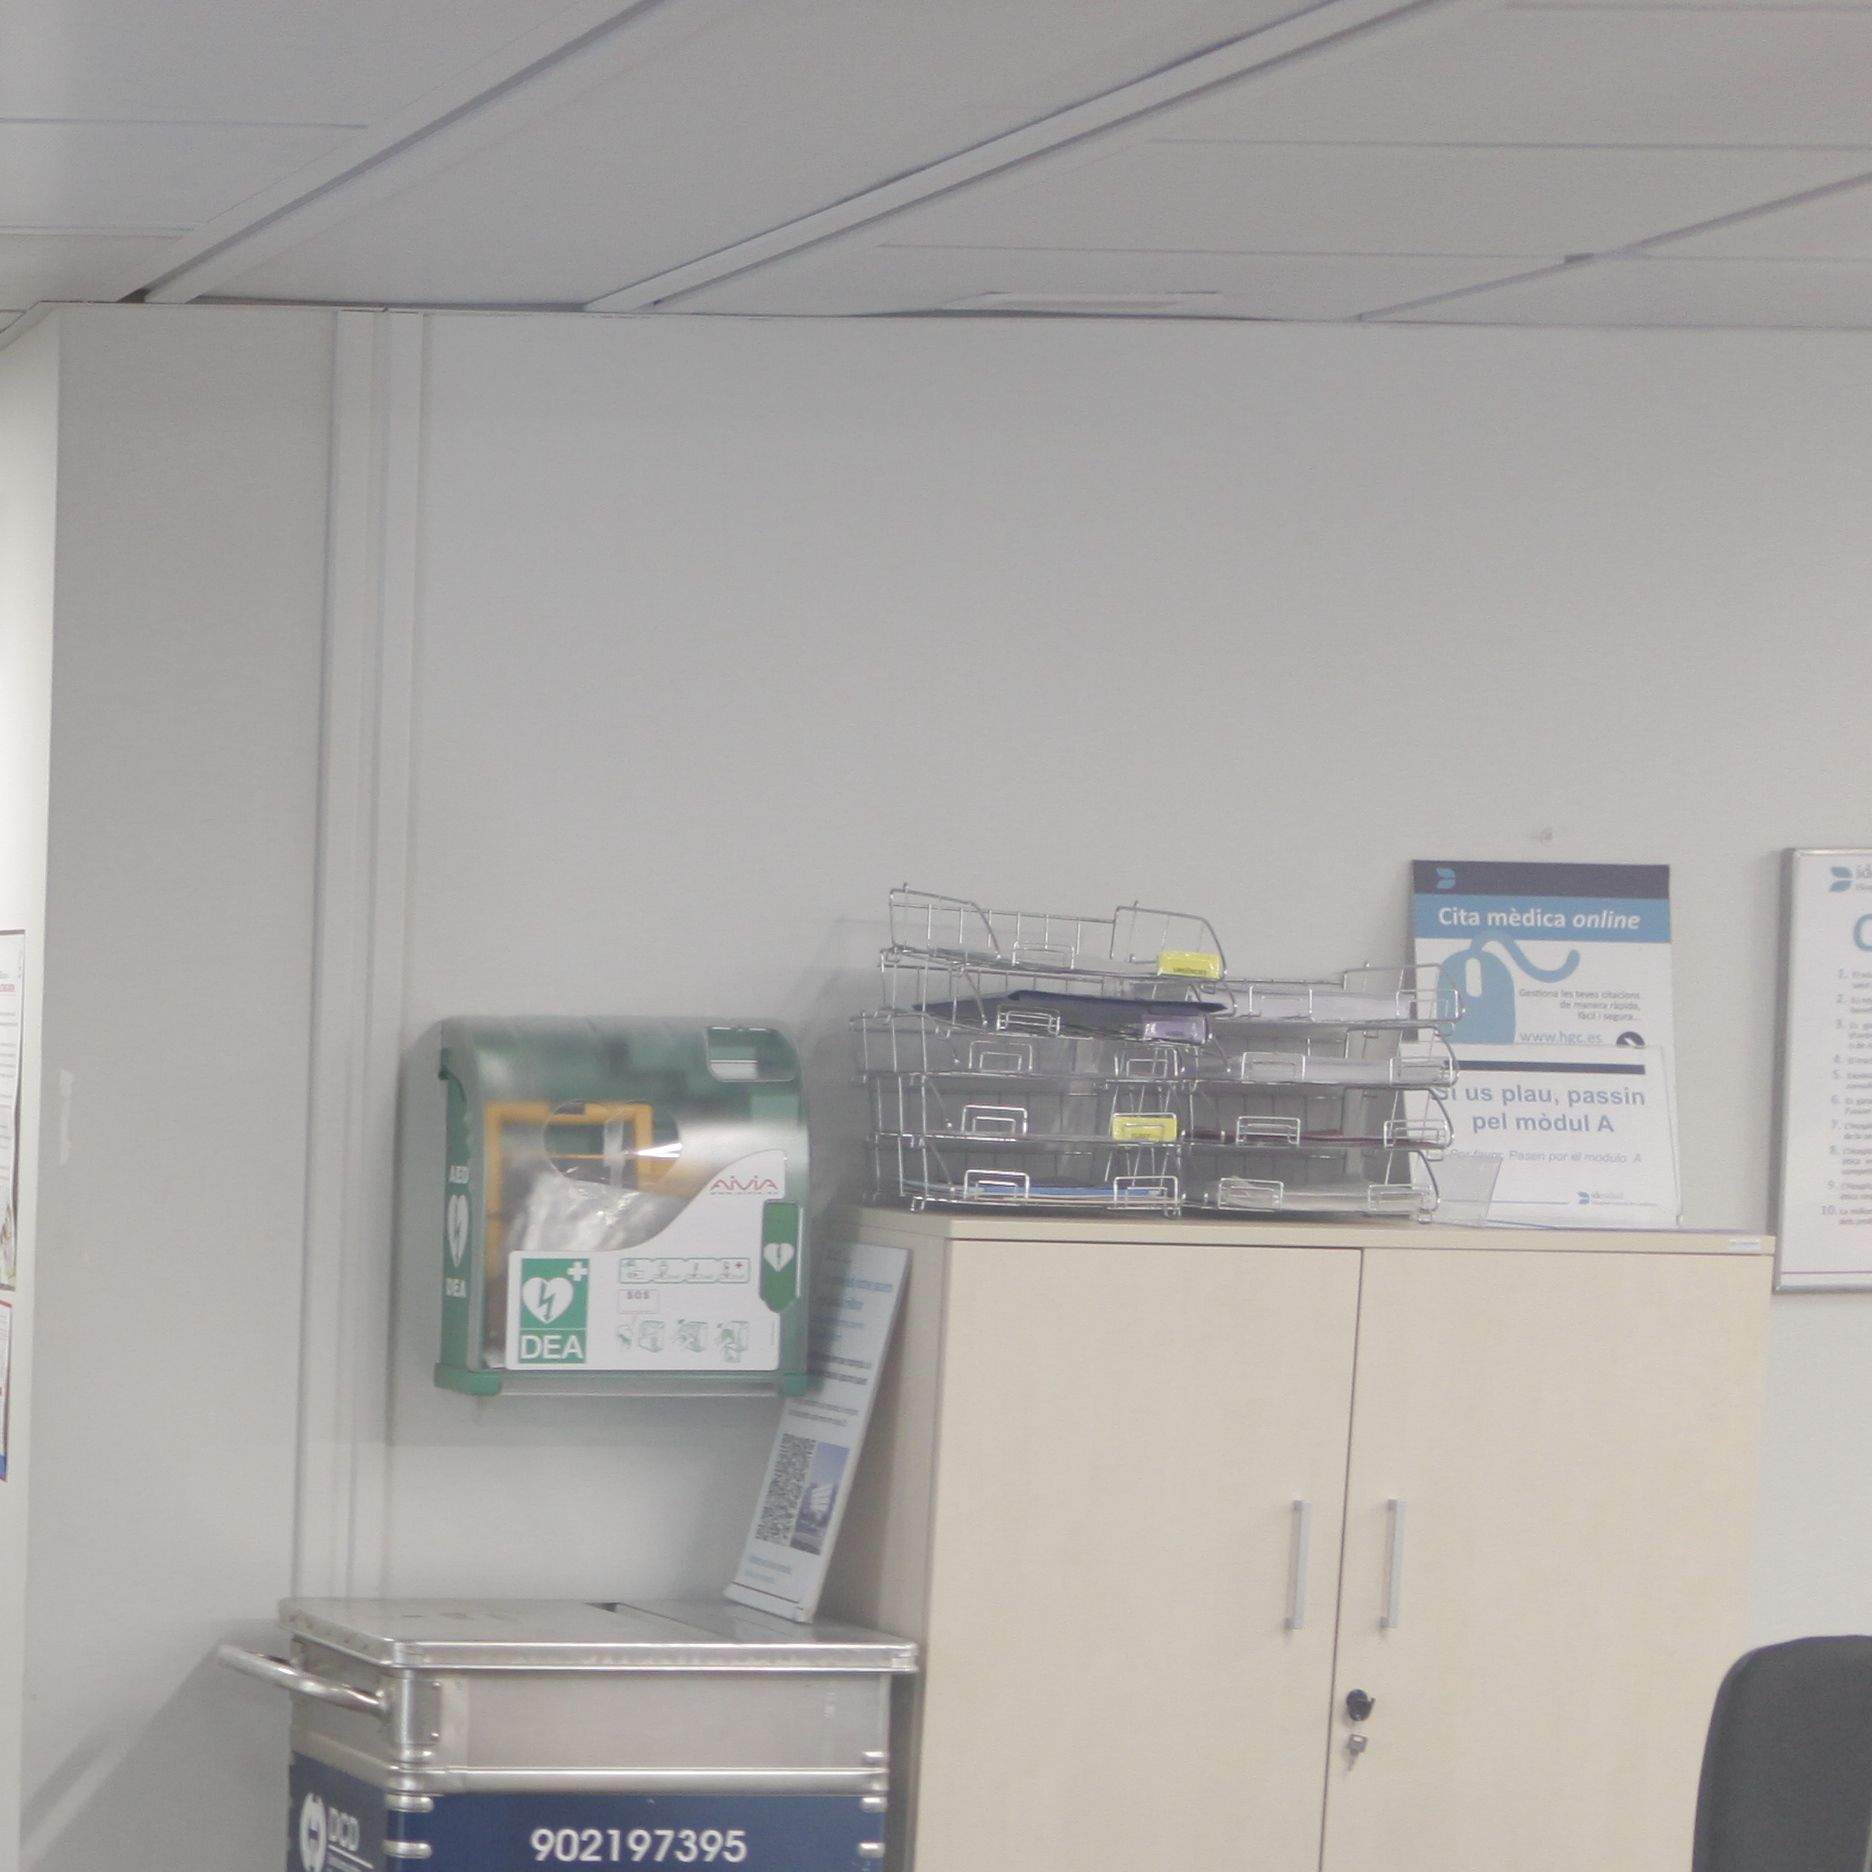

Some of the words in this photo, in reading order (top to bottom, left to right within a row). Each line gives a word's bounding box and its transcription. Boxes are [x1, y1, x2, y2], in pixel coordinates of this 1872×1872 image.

[1437, 906, 1481, 927] Cita
[1486, 907, 1566, 929] mèdica
[1572, 909, 1642, 930] online
[1559, 1000, 1572, 1010] de
[1519, 1031, 1603, 1045] www.hgc.es
[1464, 1088, 1494, 1101] us
[1502, 1084, 1560, 1107] plau,
[1567, 1087, 1646, 1108] passin
[1471, 1113, 1508, 1133] pel
[1515, 1112, 1590, 1132] mòdul
[1597, 1116, 1615, 1133] A
[1508, 1150, 1547, 1162] Pasen
[1548, 1152, 1570, 1164] por
[1632, 1153, 1643, 1164] A
[626, 1290, 651, 1300] SOS
[518, 1334, 584, 1361] DEA
[327, 1806, 360, 1852] DCD
[529, 1828, 748, 1864] 902197395
